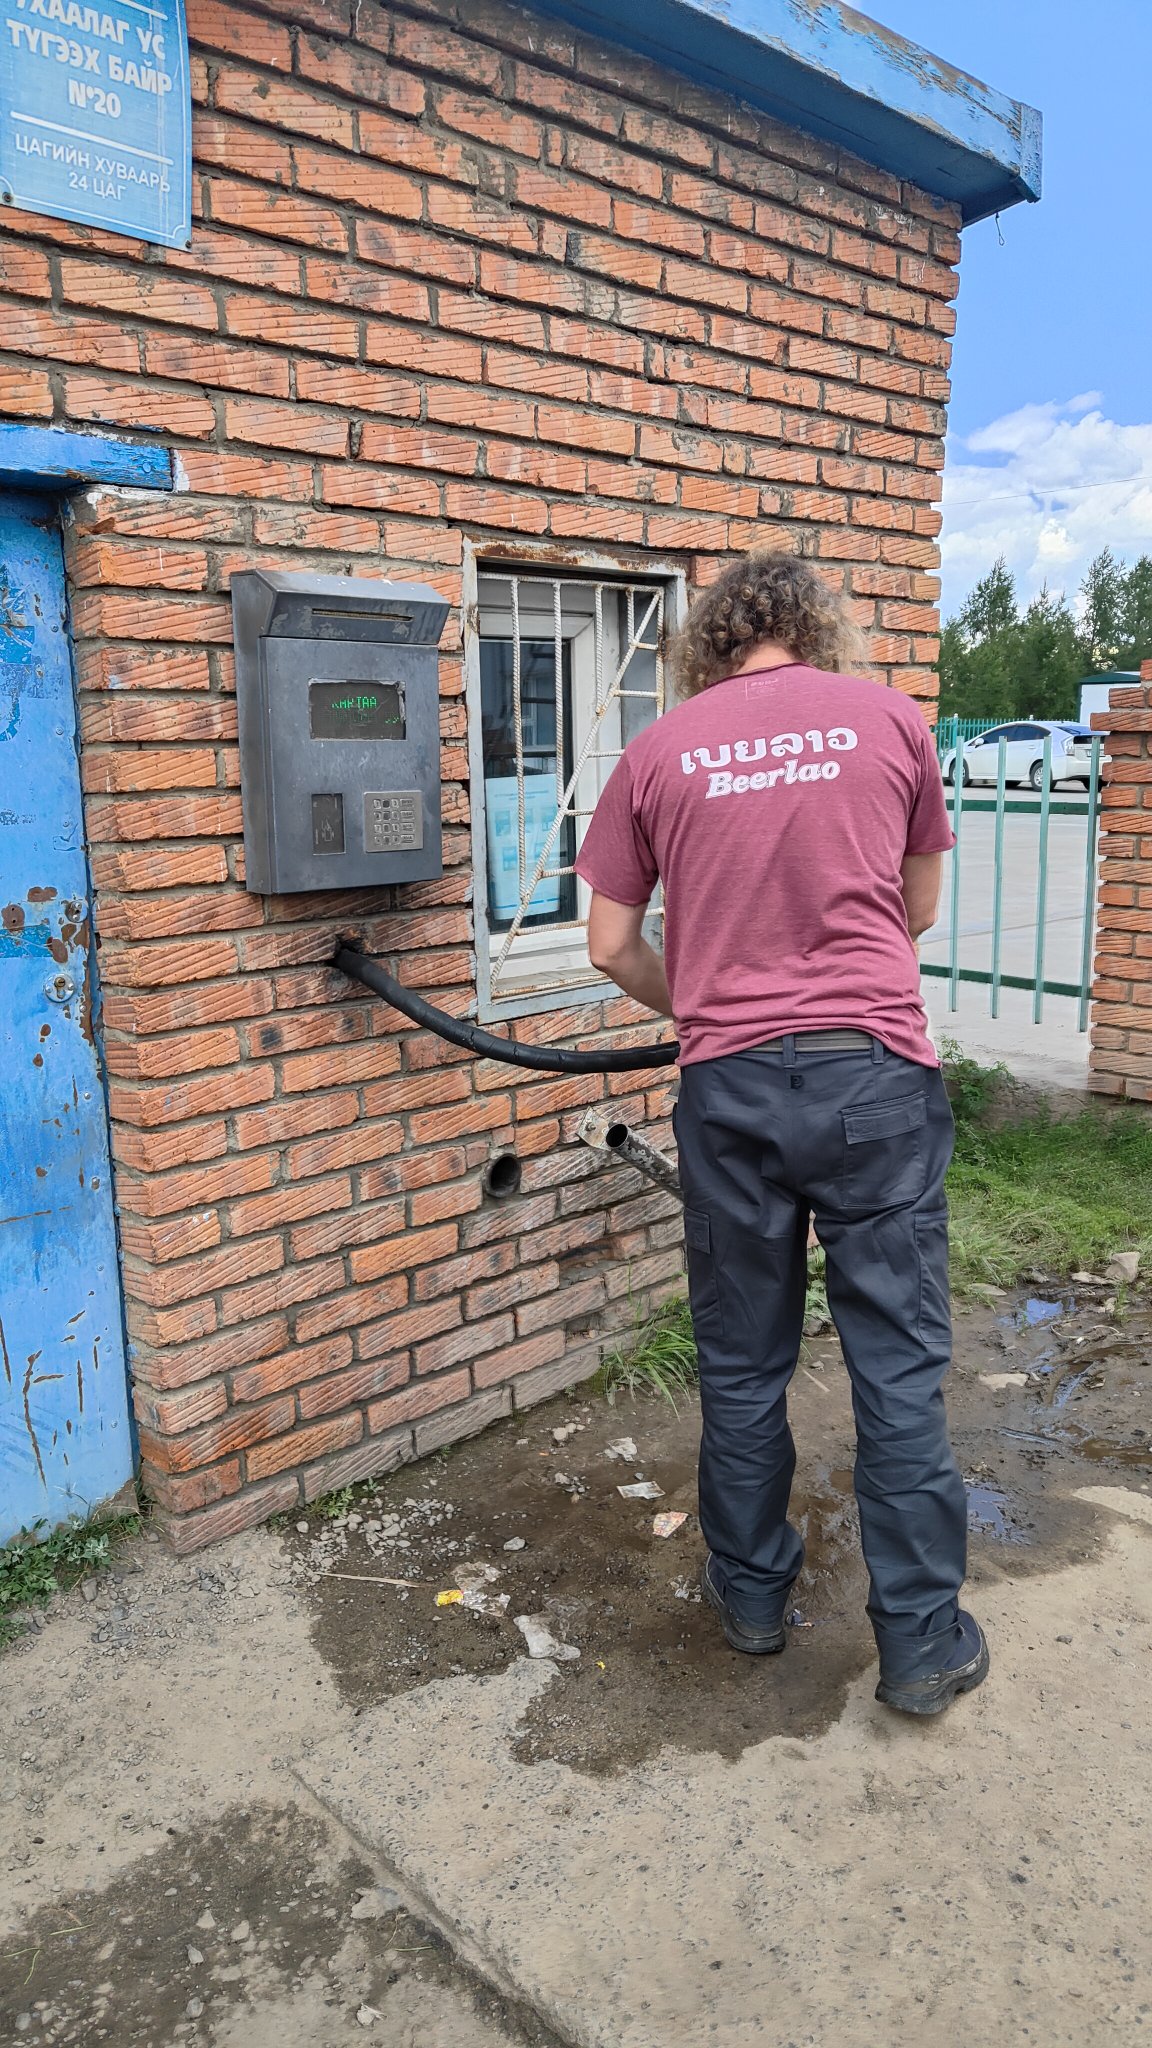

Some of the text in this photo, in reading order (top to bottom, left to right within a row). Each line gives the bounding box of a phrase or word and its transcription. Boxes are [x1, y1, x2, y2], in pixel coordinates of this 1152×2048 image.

[6, 18, 172, 96] ТҮГЭЭХ БАЙР
[15, 133, 170, 193] ЦАГИЙН ХУВААРЬ
[69, 172, 126, 201] 24 ЦАГ
[681, 727, 858, 775] ເບຍລາວ
[705, 759, 841, 799] Beerlao
